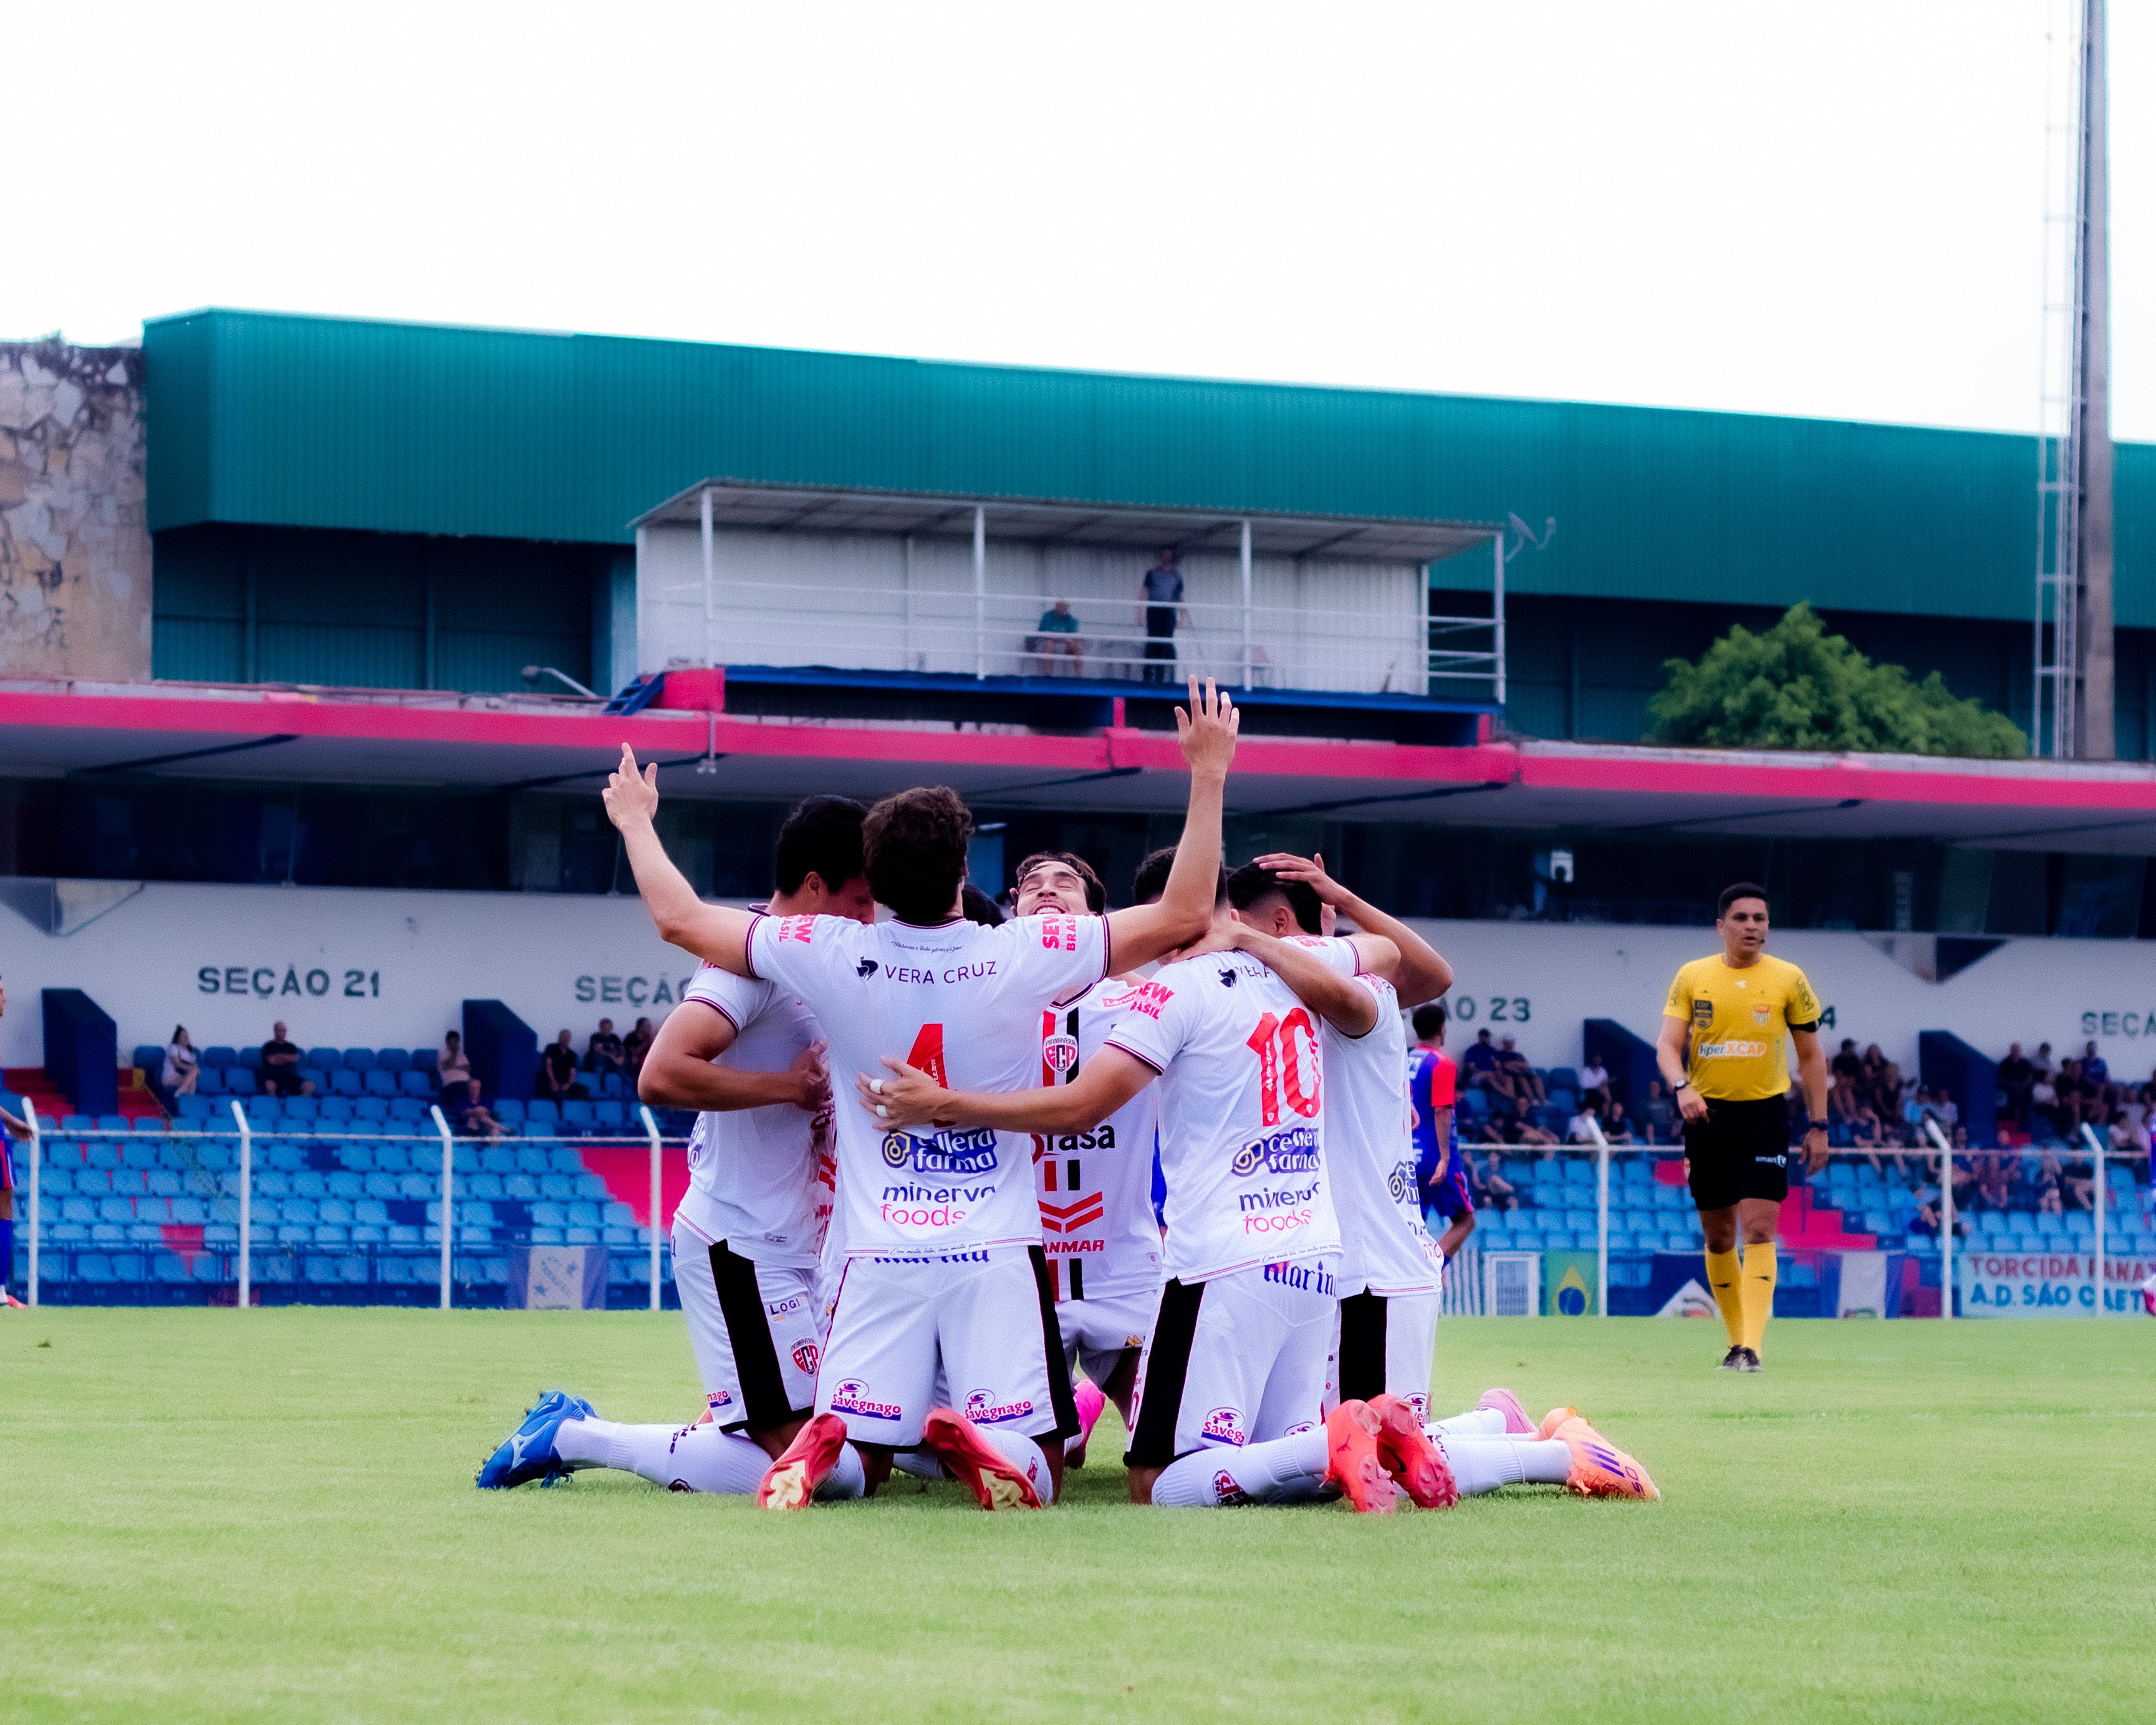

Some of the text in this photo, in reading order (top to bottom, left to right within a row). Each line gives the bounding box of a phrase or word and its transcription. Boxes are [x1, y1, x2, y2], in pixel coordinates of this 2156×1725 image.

[344, 969, 379, 998] 21
[885, 961, 997, 984] VERA CRUZ
[1489, 997, 1531, 1022] 23
[1818, 1005, 1836, 1030] 4
[1246, 1008, 1321, 1126] 10
[1969, 1257, 2081, 1278] TORCIDA
[832, 1393, 902, 1416] Savegnago
[965, 1401, 1032, 1419] Savegnago
